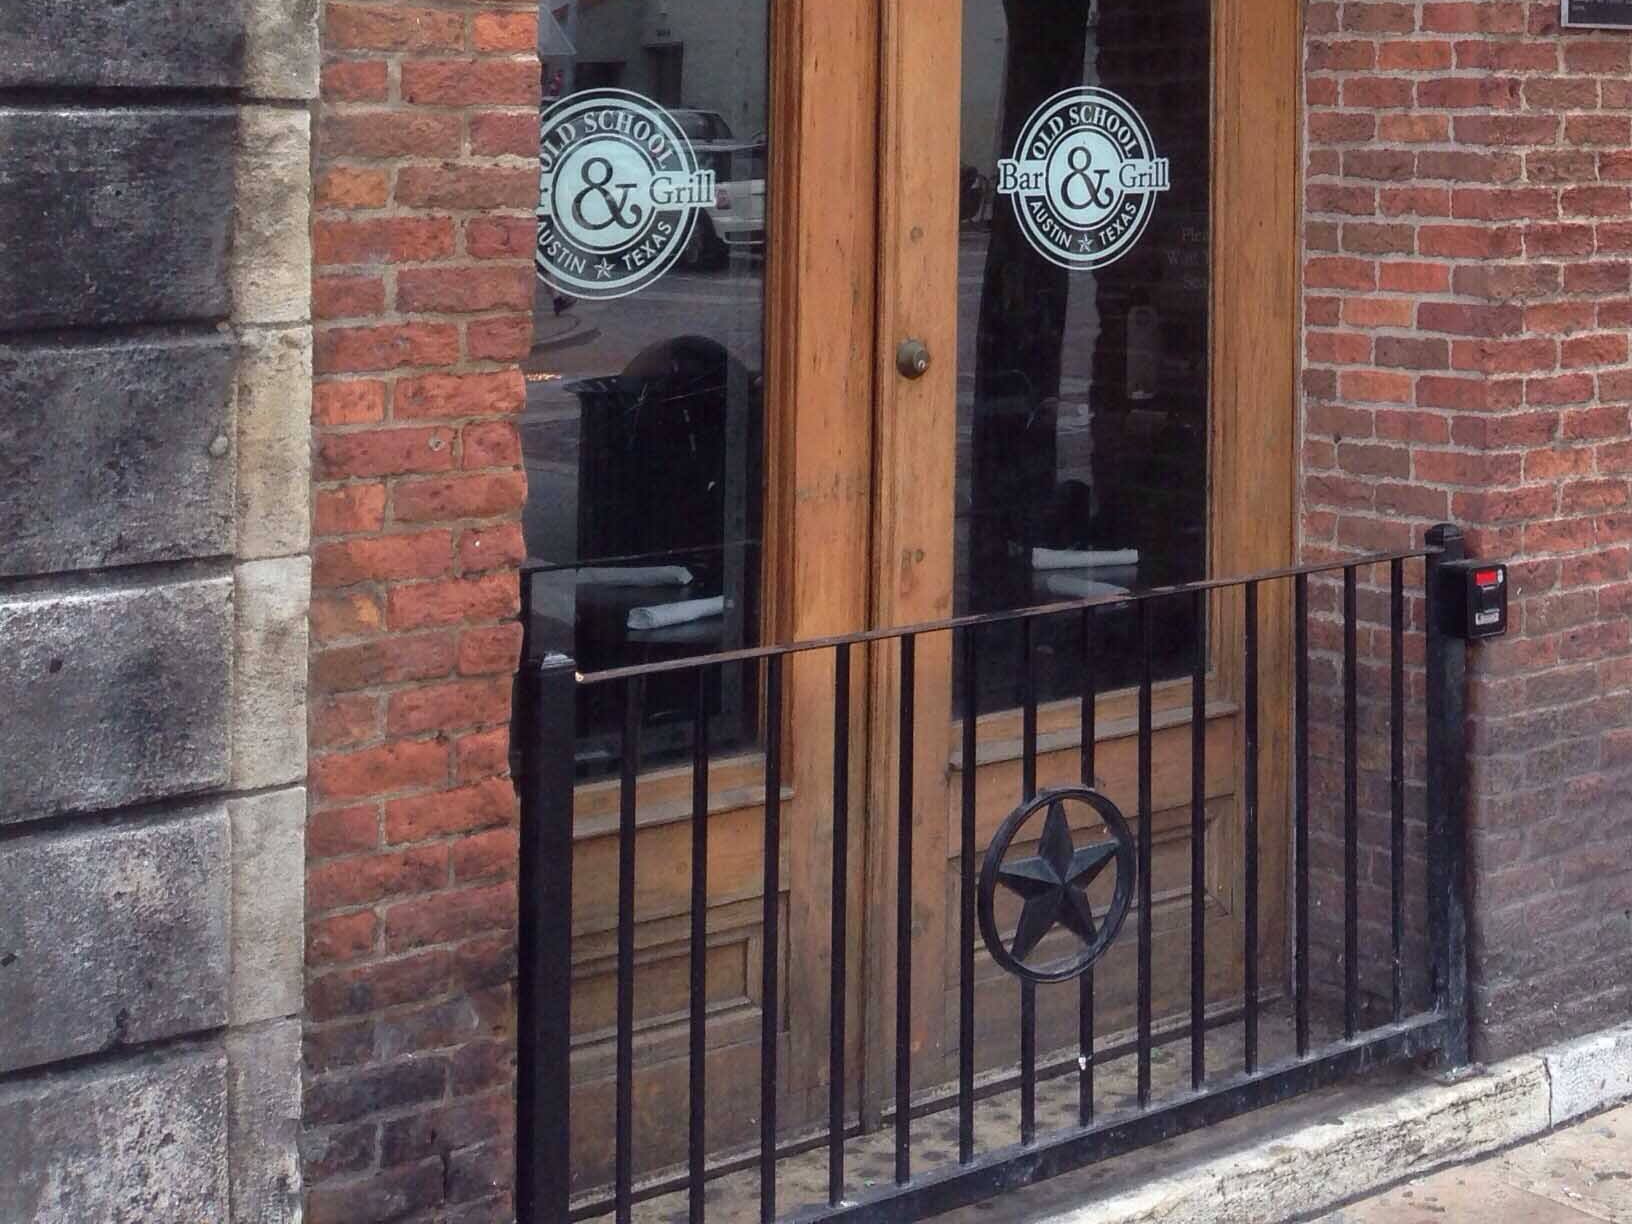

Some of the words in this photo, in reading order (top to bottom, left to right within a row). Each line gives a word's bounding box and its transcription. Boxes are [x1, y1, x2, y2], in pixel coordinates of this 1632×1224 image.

[540, 123, 577, 172] OLD
[584, 110, 675, 169] SCHOOL
[1032, 116, 1064, 159] OLD
[1069, 104, 1139, 157] SCHOOL
[571, 157, 642, 231] &
[650, 174, 712, 205] Grill
[1000, 162, 1043, 191] Bar
[1061, 146, 1114, 210] &
[1119, 161, 1168, 188] Grill
[621, 221, 672, 271] TEXAS
[1029, 201, 1073, 249] AUSTIN
[1099, 202, 1137, 246] TEXAS
